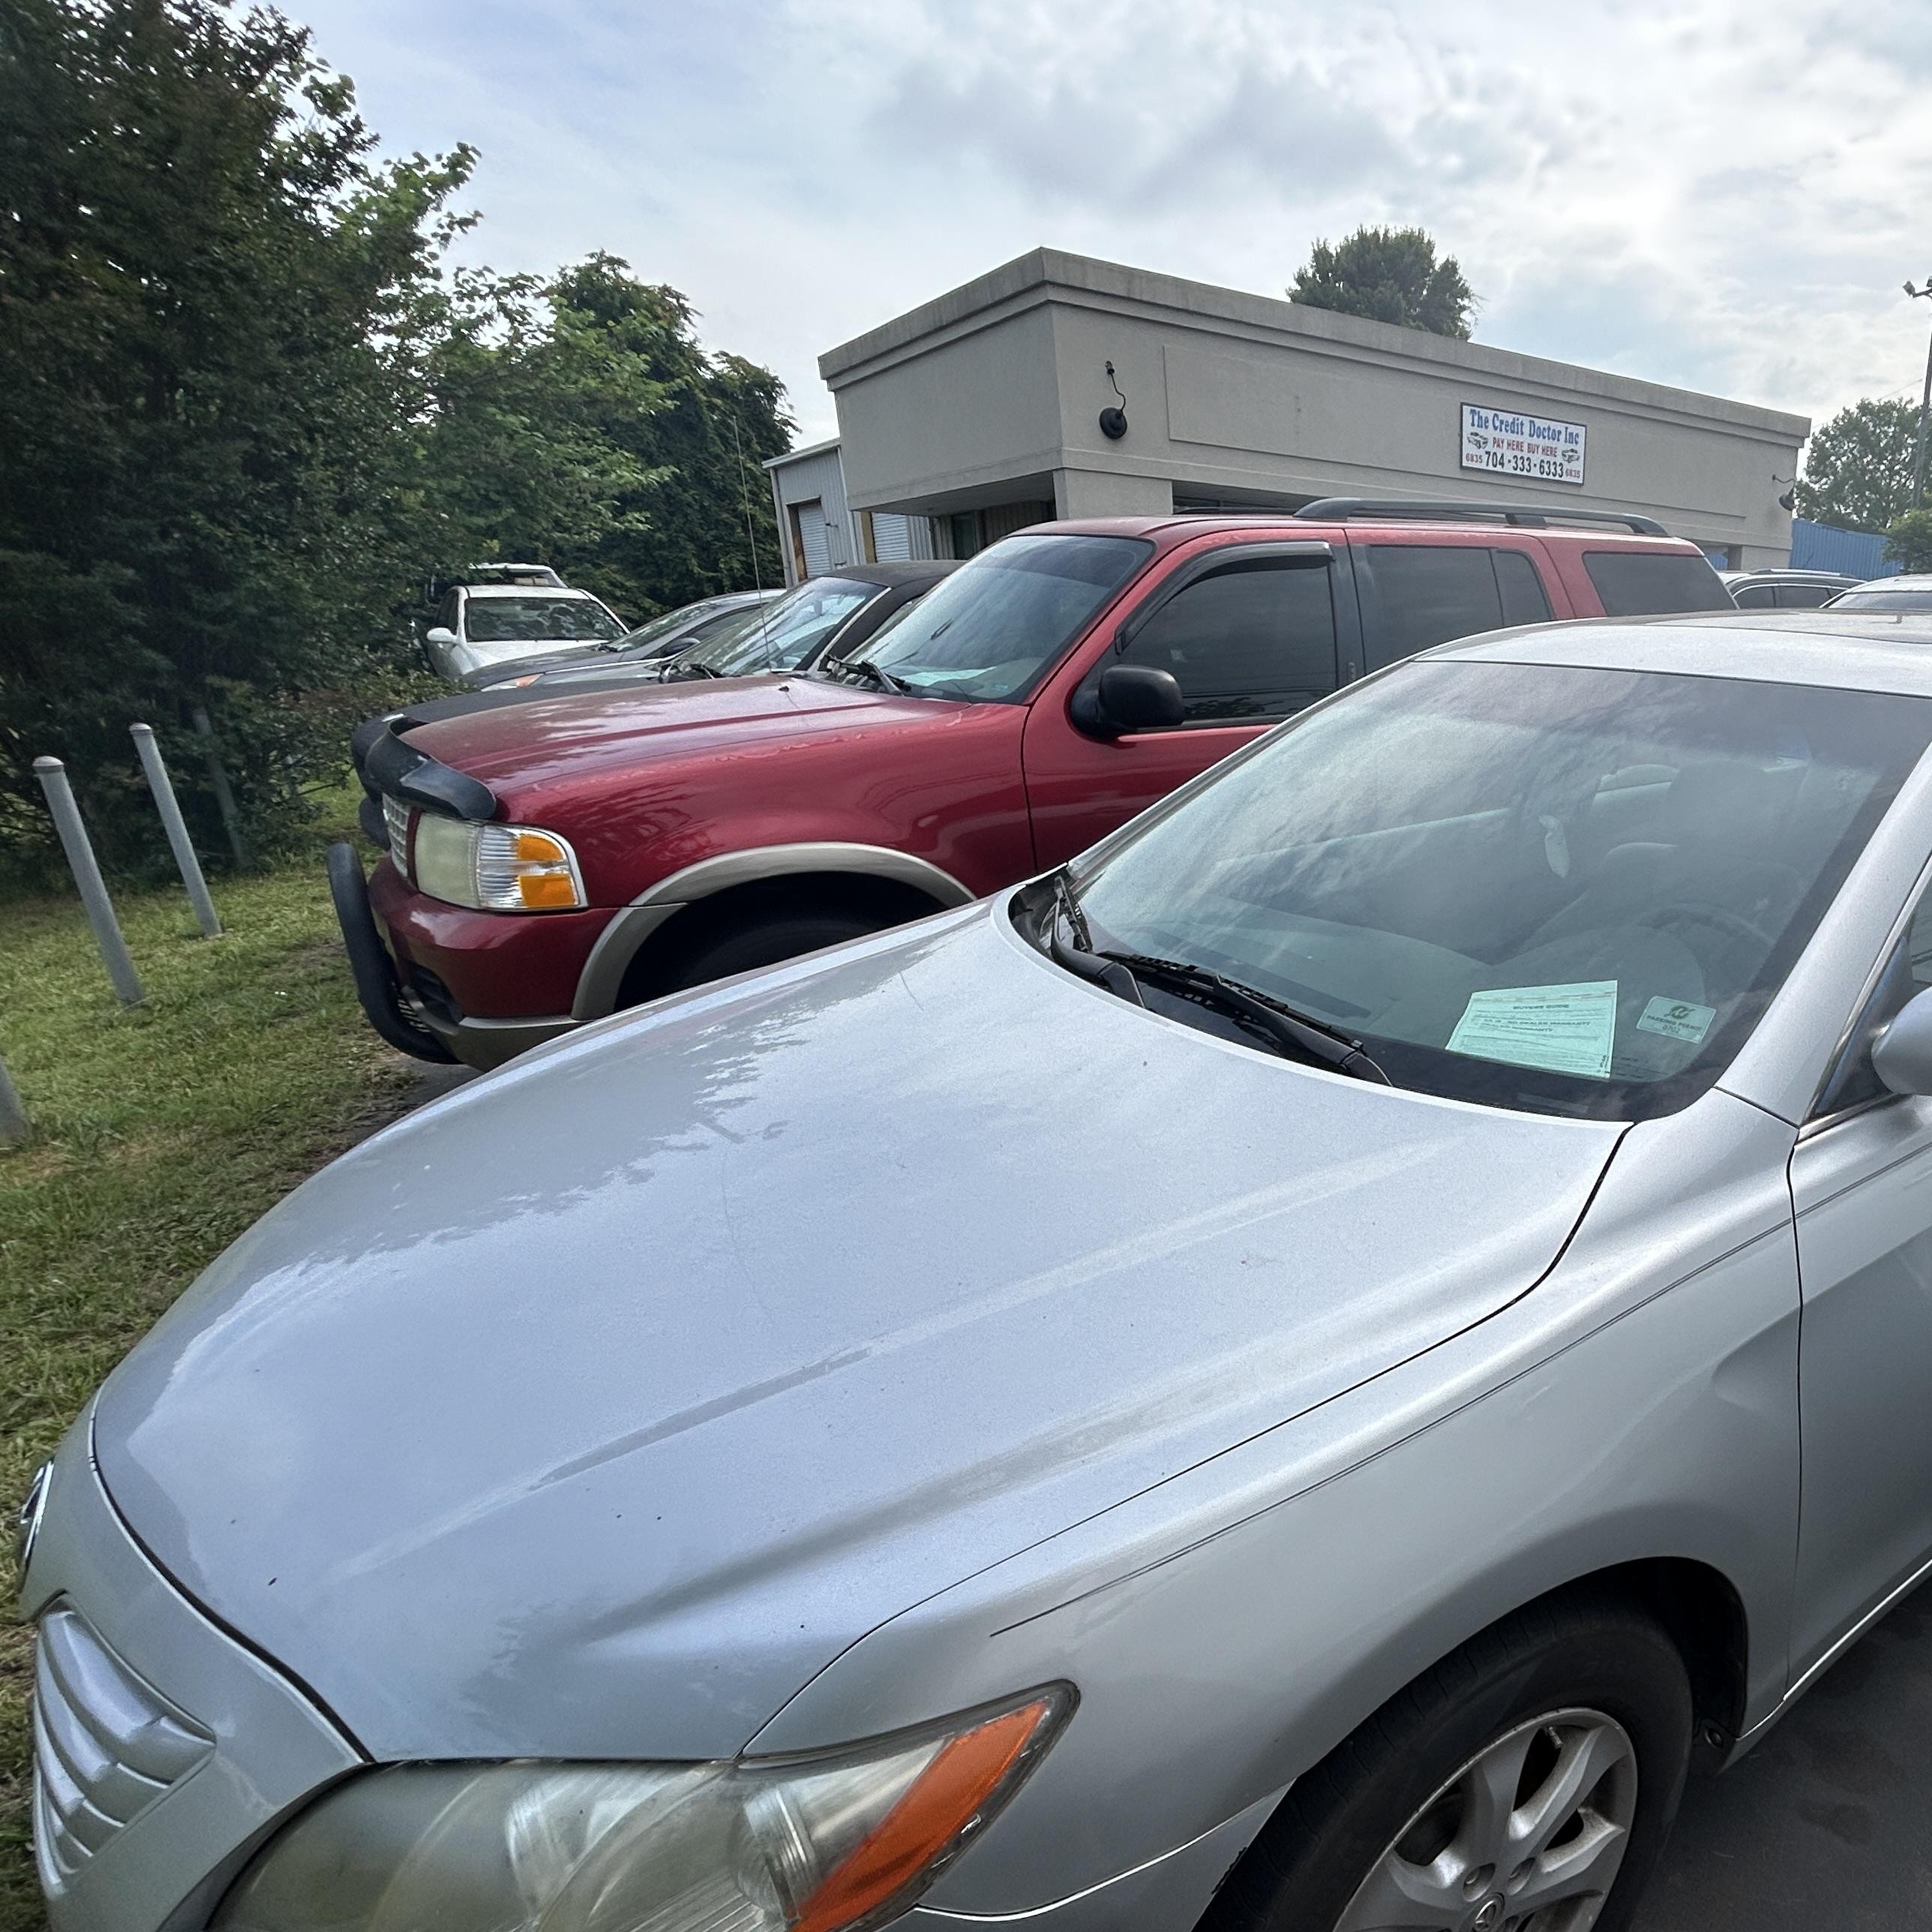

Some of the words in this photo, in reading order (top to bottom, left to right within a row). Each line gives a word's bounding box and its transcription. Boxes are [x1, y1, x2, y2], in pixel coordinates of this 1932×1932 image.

[1470, 409, 1490, 430] The
[1492, 413, 1524, 436] Credit
[1528, 420, 1562, 442] Doctor
[1564, 426, 1580, 446] Inc
[1492, 436, 1504, 448] PAY
[1507, 439, 1524, 452] HERE
[1527, 442, 1540, 454] BUY
[1541, 445, 1558, 458] HERE
[1466, 453, 1483, 464] 6835
[1646, 1015, 1677, 1026] PARKING
